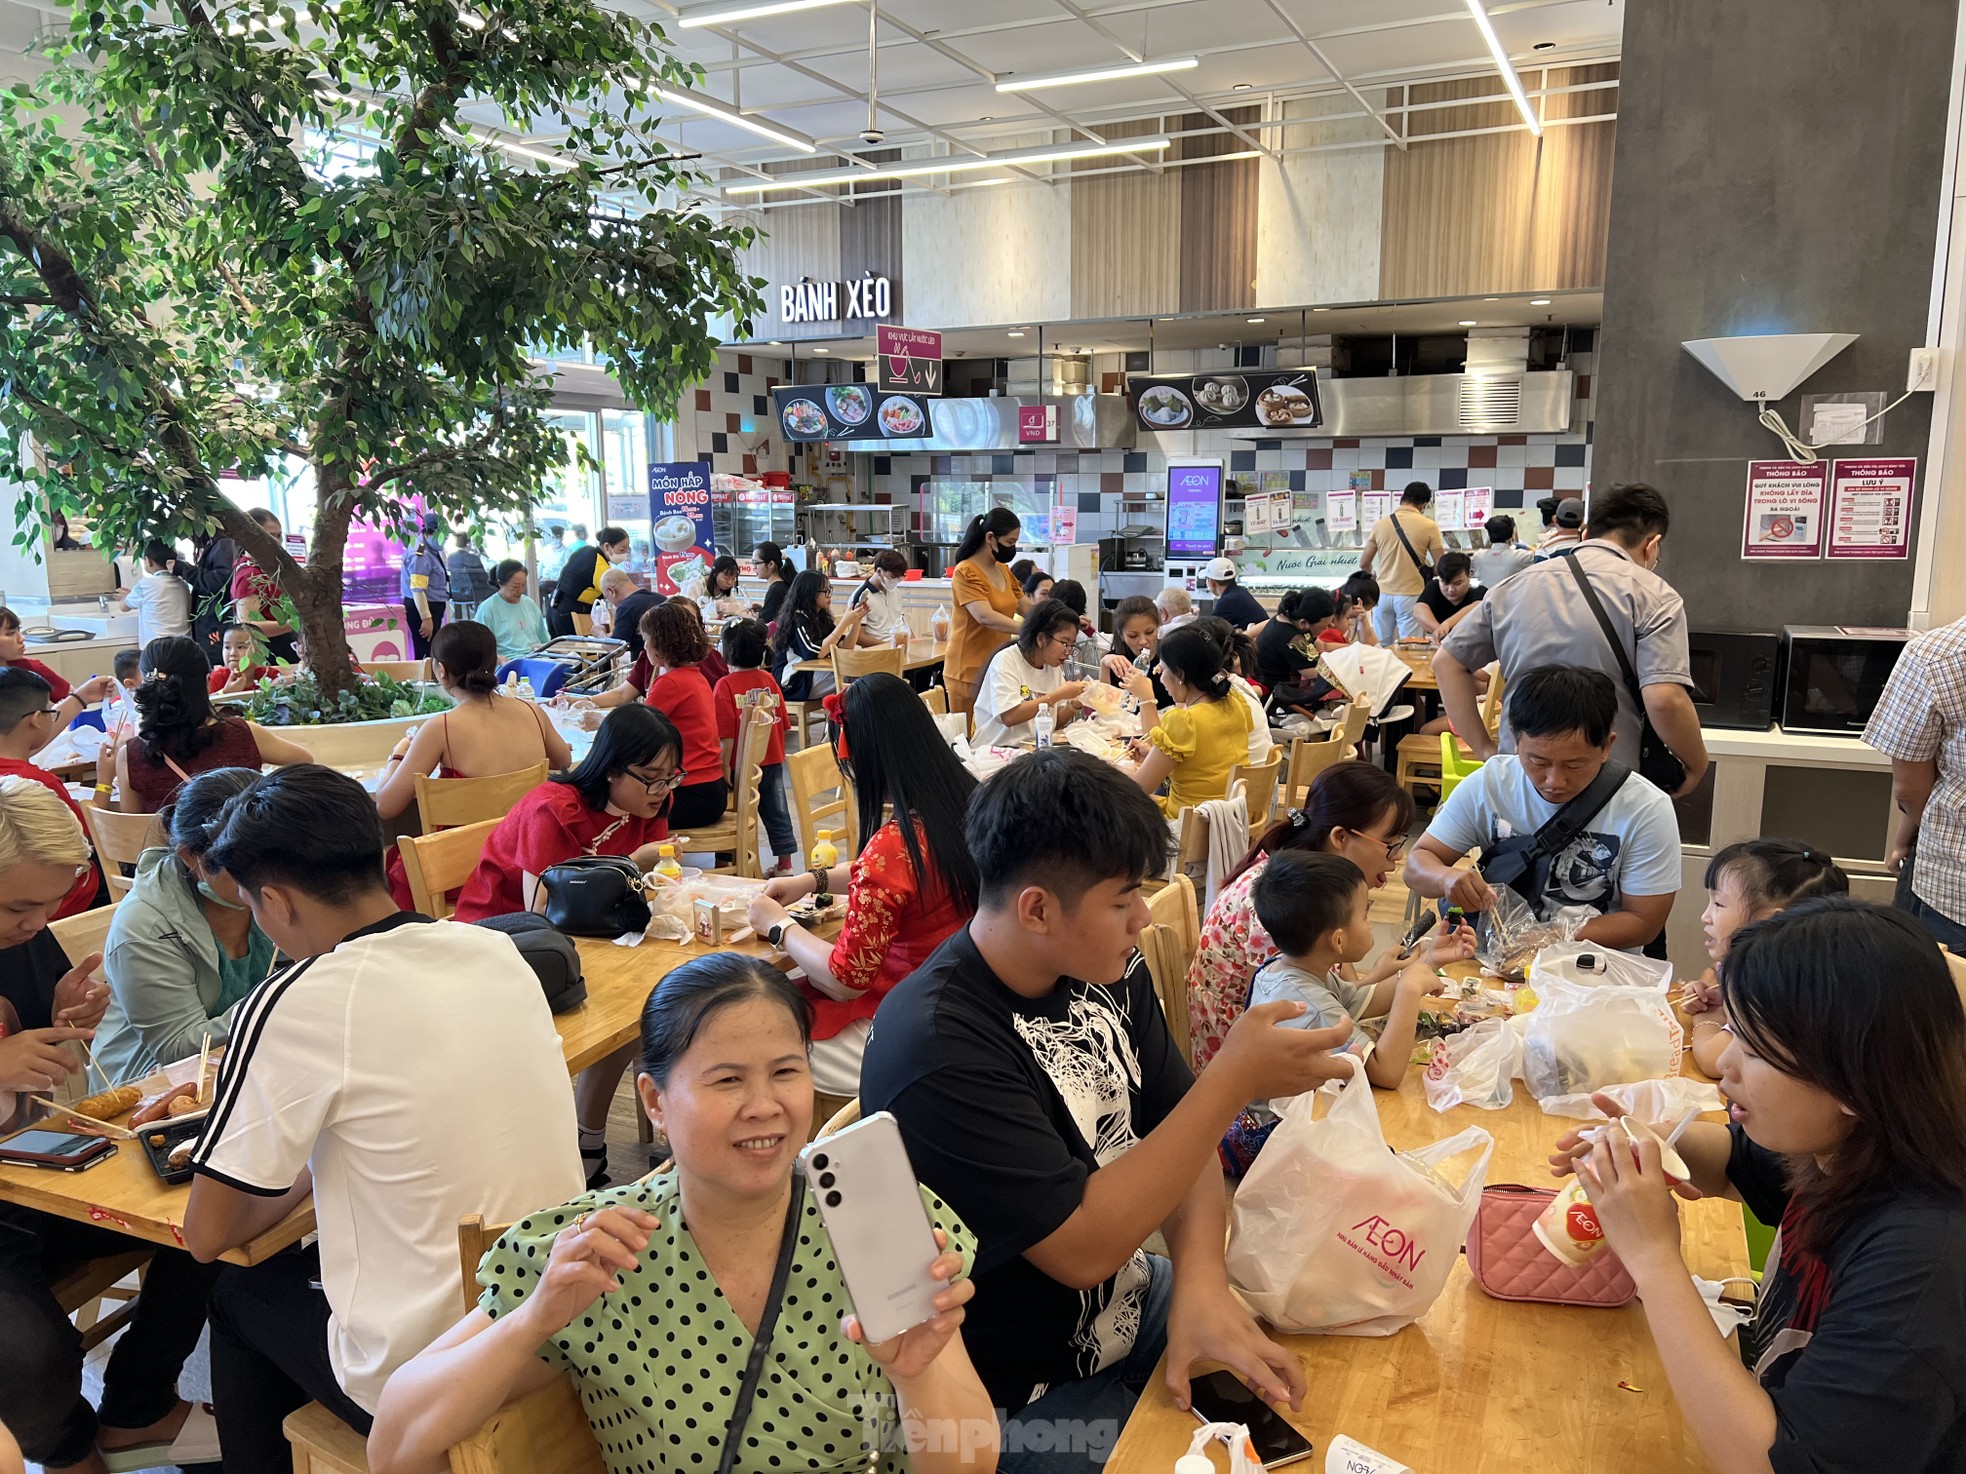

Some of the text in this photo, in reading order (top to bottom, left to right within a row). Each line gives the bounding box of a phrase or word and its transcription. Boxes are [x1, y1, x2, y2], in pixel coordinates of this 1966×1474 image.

[781, 270, 890, 323] BÁNH XÈO
[888, 332, 898, 340] KHU
[1792, 469, 1807, 477] BÁO
[652, 475, 679, 489] MÓN
[664, 487, 708, 506] NÓNG
